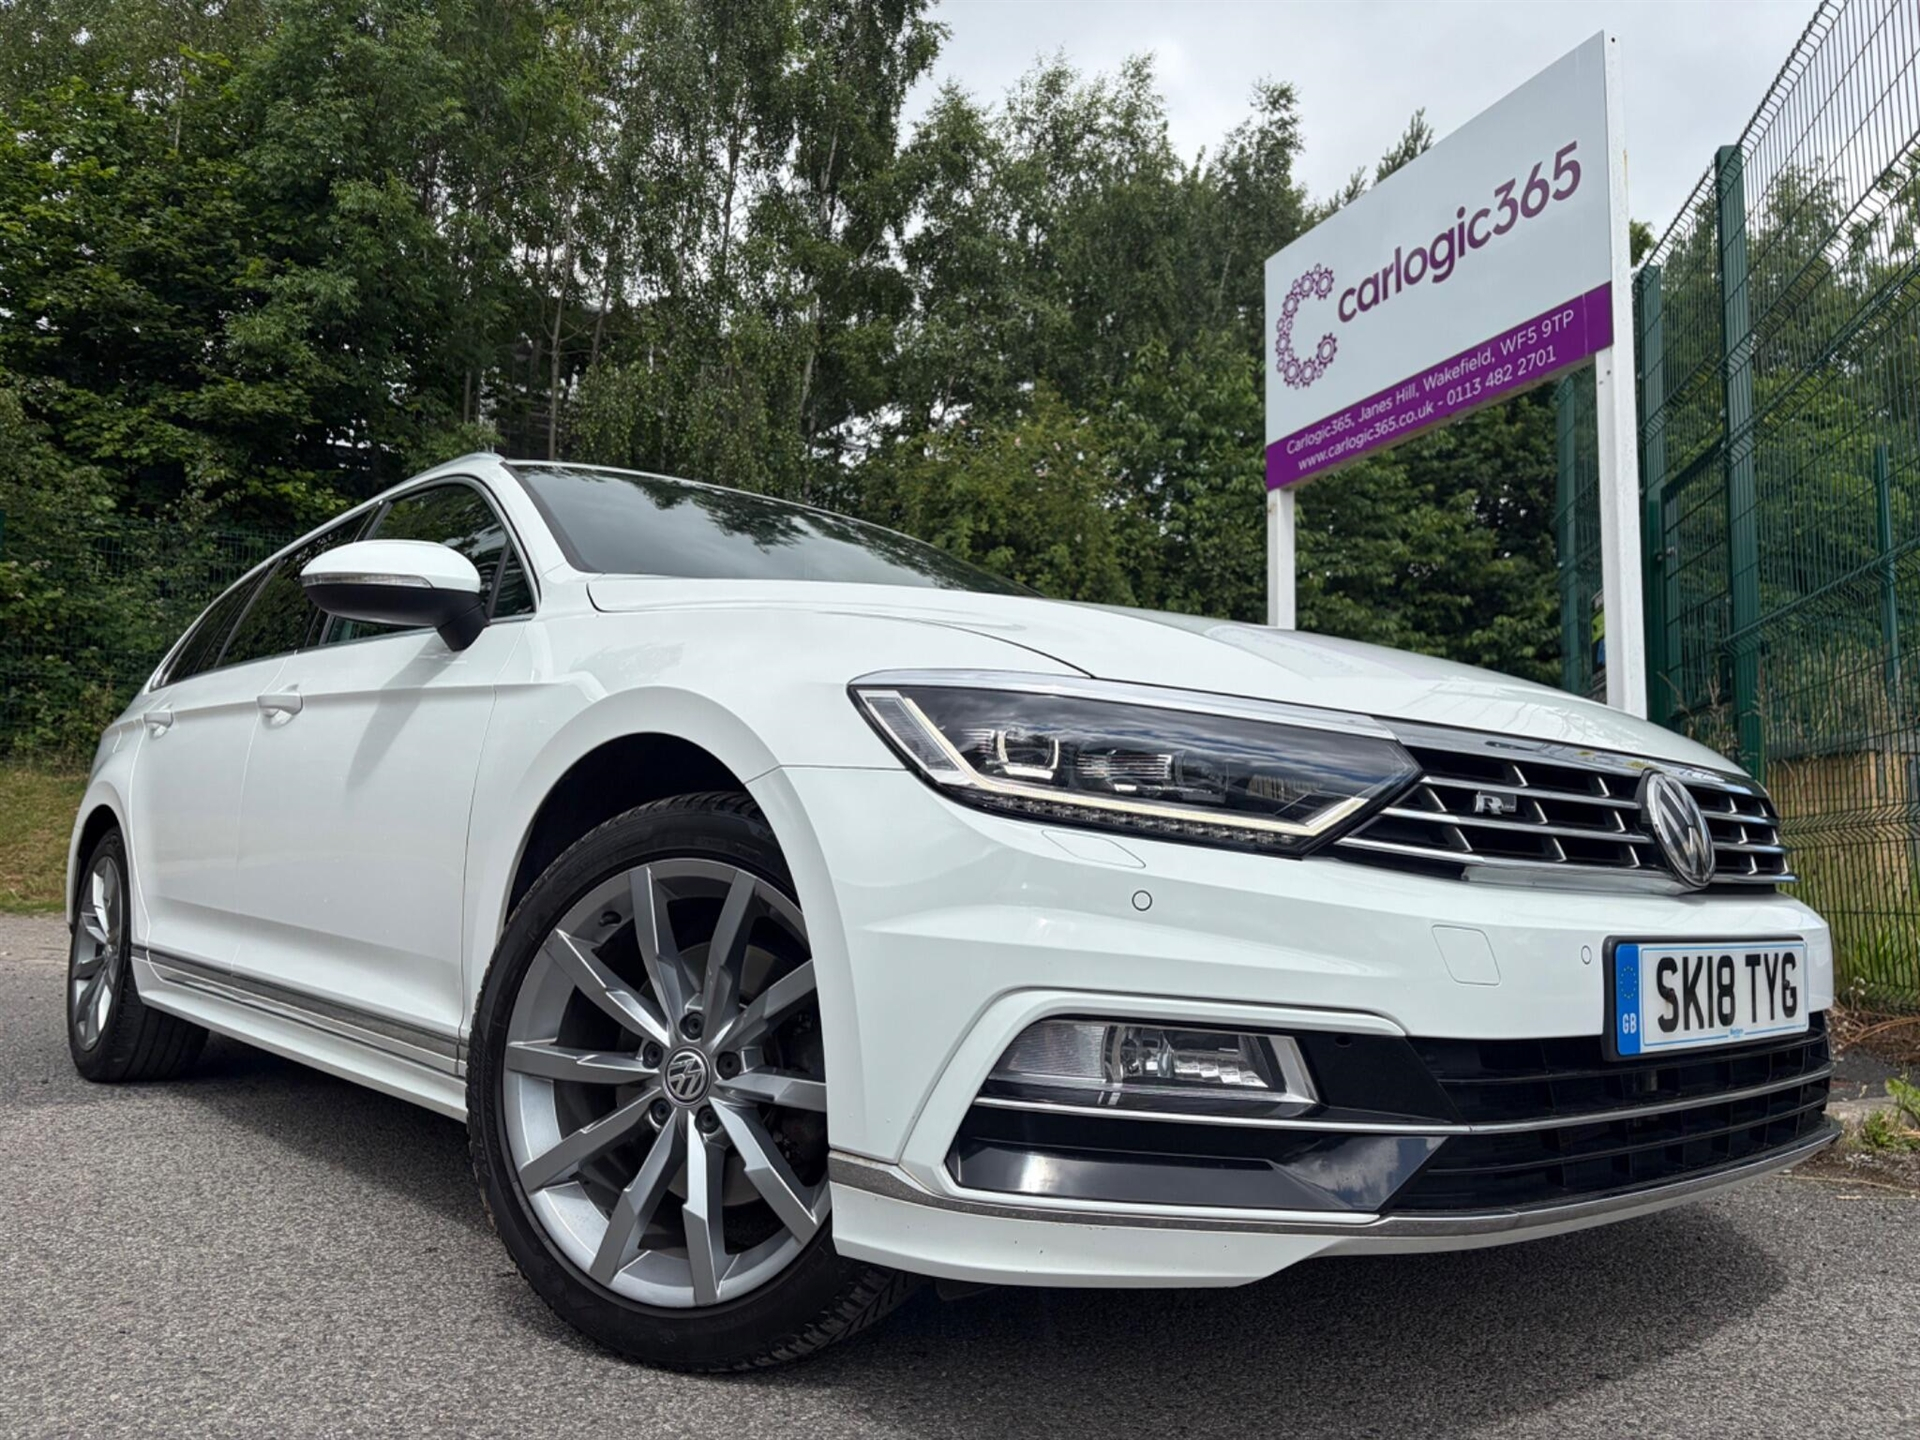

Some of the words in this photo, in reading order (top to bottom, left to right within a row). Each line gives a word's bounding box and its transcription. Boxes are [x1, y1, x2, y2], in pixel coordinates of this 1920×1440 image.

[1338, 140, 1582, 322] carlogic365
[1286, 413, 1355, 454] Carlogic365,
[1358, 396, 1393, 423] Janes
[1396, 383, 1419, 405] Hill,
[1423, 347, 1495, 392] Wakefield,
[1500, 326, 1537, 356] WF5
[1541, 309, 1574, 338] 9TP
[1298, 400, 1434, 470] www.carlogic365.co.uk
[1446, 377, 1481, 406] 0113
[1485, 364, 1512, 387] 482
[1517, 345, 1556, 376] 2701
[1622, 1012, 1637, 1035] GB
[1656, 954, 1736, 1033] SK18
[1745, 952, 1798, 1023] TYG
